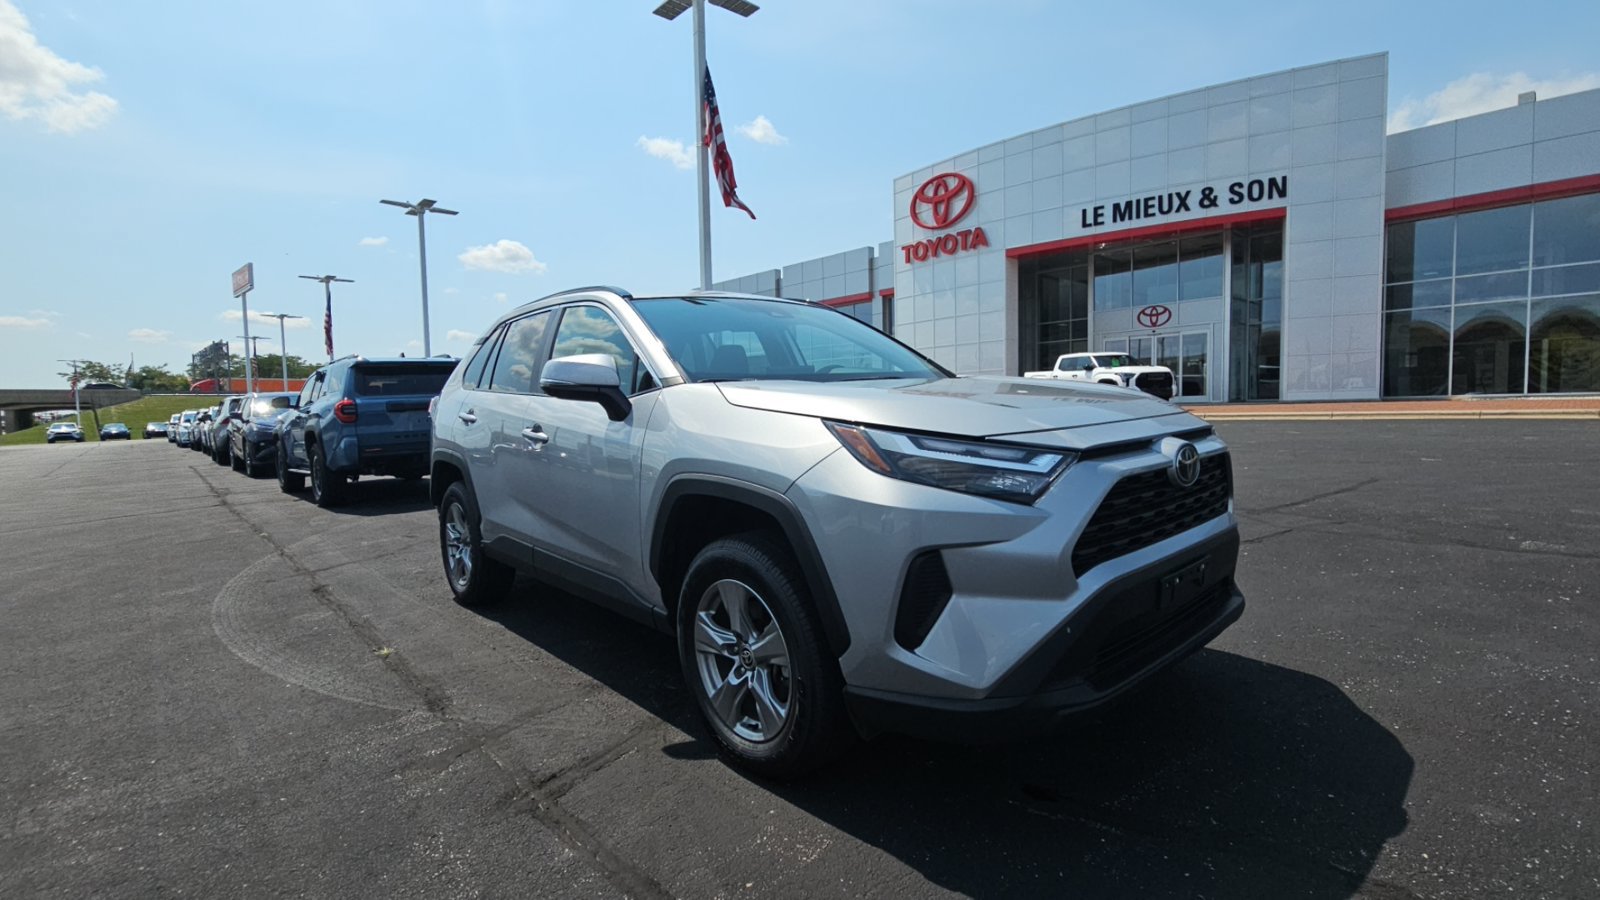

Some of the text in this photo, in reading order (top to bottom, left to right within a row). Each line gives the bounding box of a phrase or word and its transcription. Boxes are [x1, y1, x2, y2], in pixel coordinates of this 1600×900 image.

[1081, 175, 1288, 229] LE MIEUX & SON
[901, 227, 988, 264] TOYOTA
